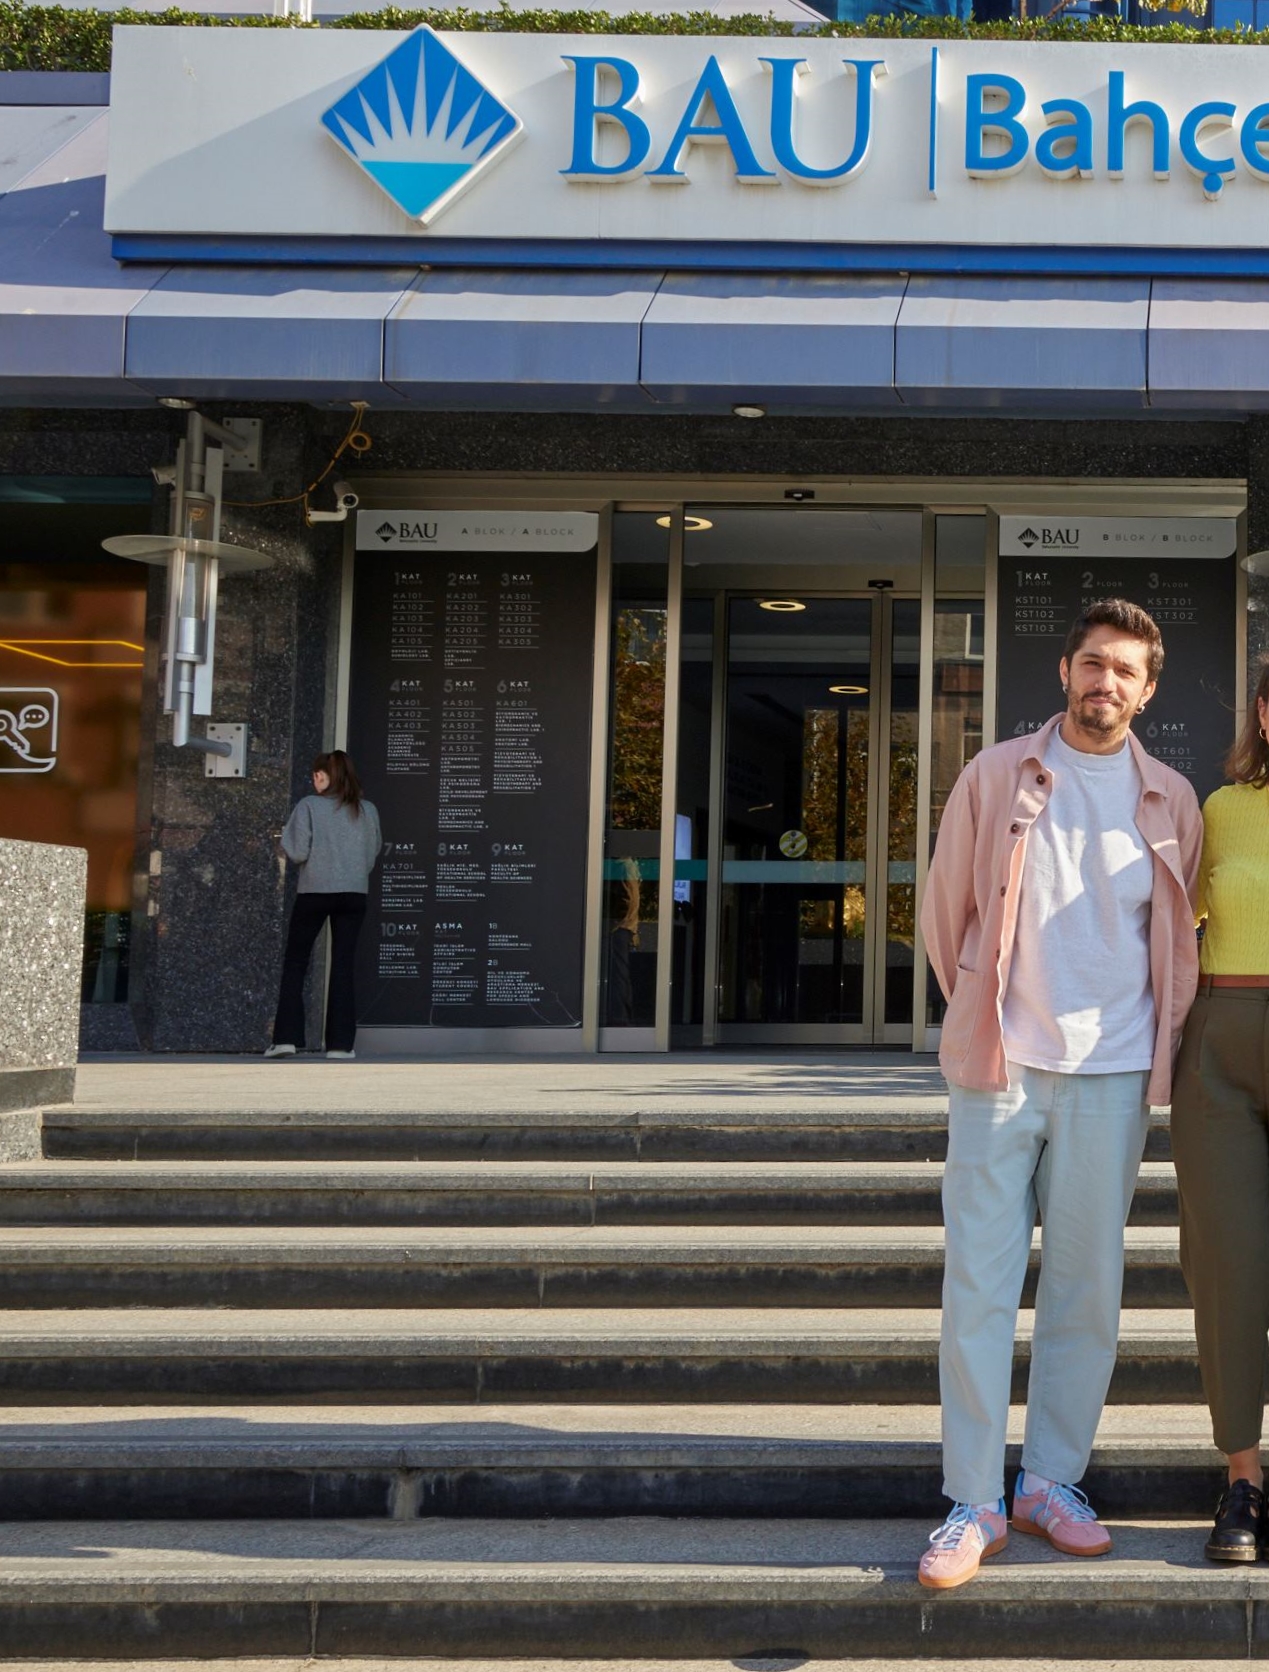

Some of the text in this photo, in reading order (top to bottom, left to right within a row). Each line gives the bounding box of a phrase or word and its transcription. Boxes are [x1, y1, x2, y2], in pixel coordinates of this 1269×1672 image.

[559, 54, 888, 184] BAU
[399, 522, 438, 539] BAU
[474, 527, 505, 535] BLOK
[535, 528, 575, 536] BLOCK
[1041, 528, 1080, 545] BAU
[1175, 534, 1213, 542] BLOCK
[394, 572, 401, 587] 1
[447, 573, 457, 587] 2
[501, 573, 510, 587] 3
[1016, 571, 1048, 587] 1 KAT
[1082, 572, 1094, 588] 2
[1147, 573, 1159, 589] 3
[1015, 596, 1052, 604] KST101
[1147, 598, 1192, 606] KST301
[1015, 610, 1055, 618] KST102
[1014, 624, 1055, 632] KST103
[389, 680, 400, 692] 4
[443, 679, 453, 693] 5
[497, 680, 507, 693] 6
[1146, 722, 1158, 739] 6
[383, 842, 393, 856] 7
[438, 842, 447, 856] 8
[491, 843, 502, 857] 9
[380, 922, 397, 937] 10
